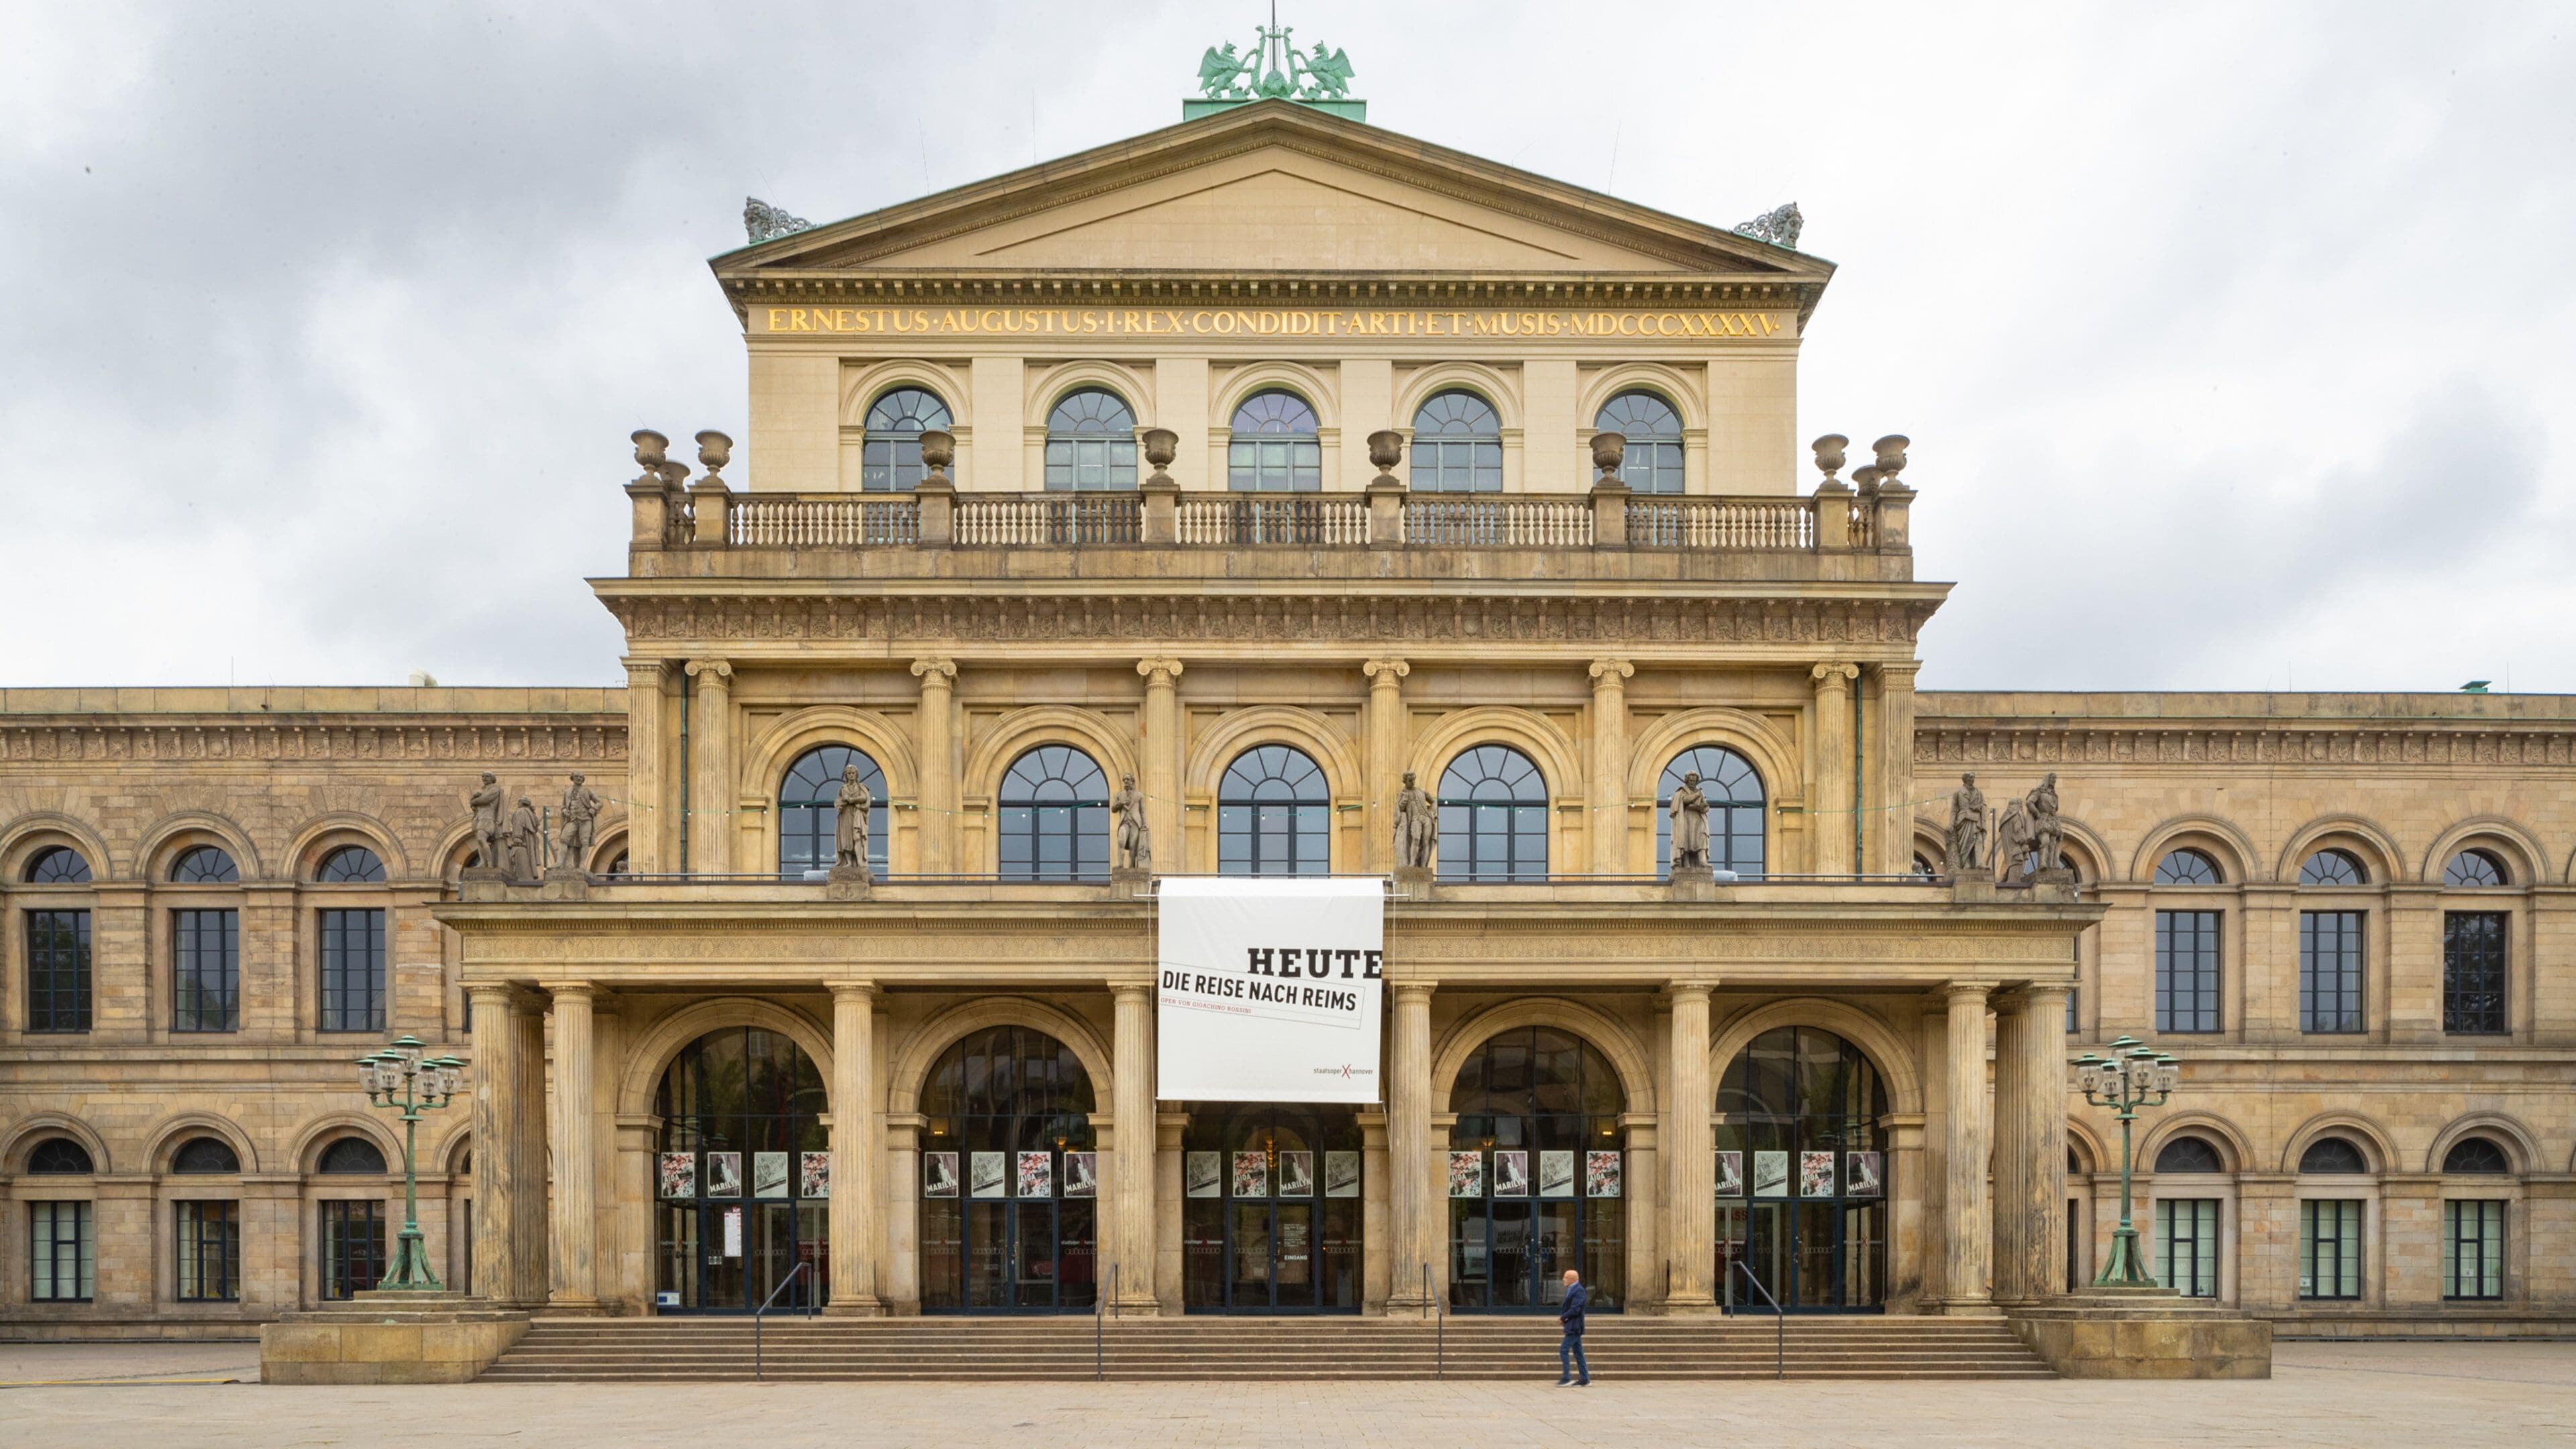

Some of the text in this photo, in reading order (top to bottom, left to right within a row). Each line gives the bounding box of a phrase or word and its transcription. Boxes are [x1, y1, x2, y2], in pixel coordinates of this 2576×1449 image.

[767, 308, 929, 333] ERNESTUS
[939, 309, 1097, 333] AUGUSTUS
[1123, 311, 1185, 333] REX
[1192, 311, 1342, 334] CONDIDIT
[1346, 311, 1417, 335] ARTI
[1425, 312, 1467, 335] ET
[1473, 312, 1561, 335] MUSIS
[1247, 947, 1383, 979] HEUTE
[1162, 970, 1357, 1012] DIE REISE NACH REIMS
[1192, 1002, 1226, 1011] GIOACHINO
[710, 1179, 741, 1193] MARILYN
[926, 1178, 957, 1193] MARILYN
[1281, 1177, 1312, 1193] MARILYN
[1495, 1177, 1526, 1192] MARILYN
[1849, 1178, 1879, 1193] MARILYN
